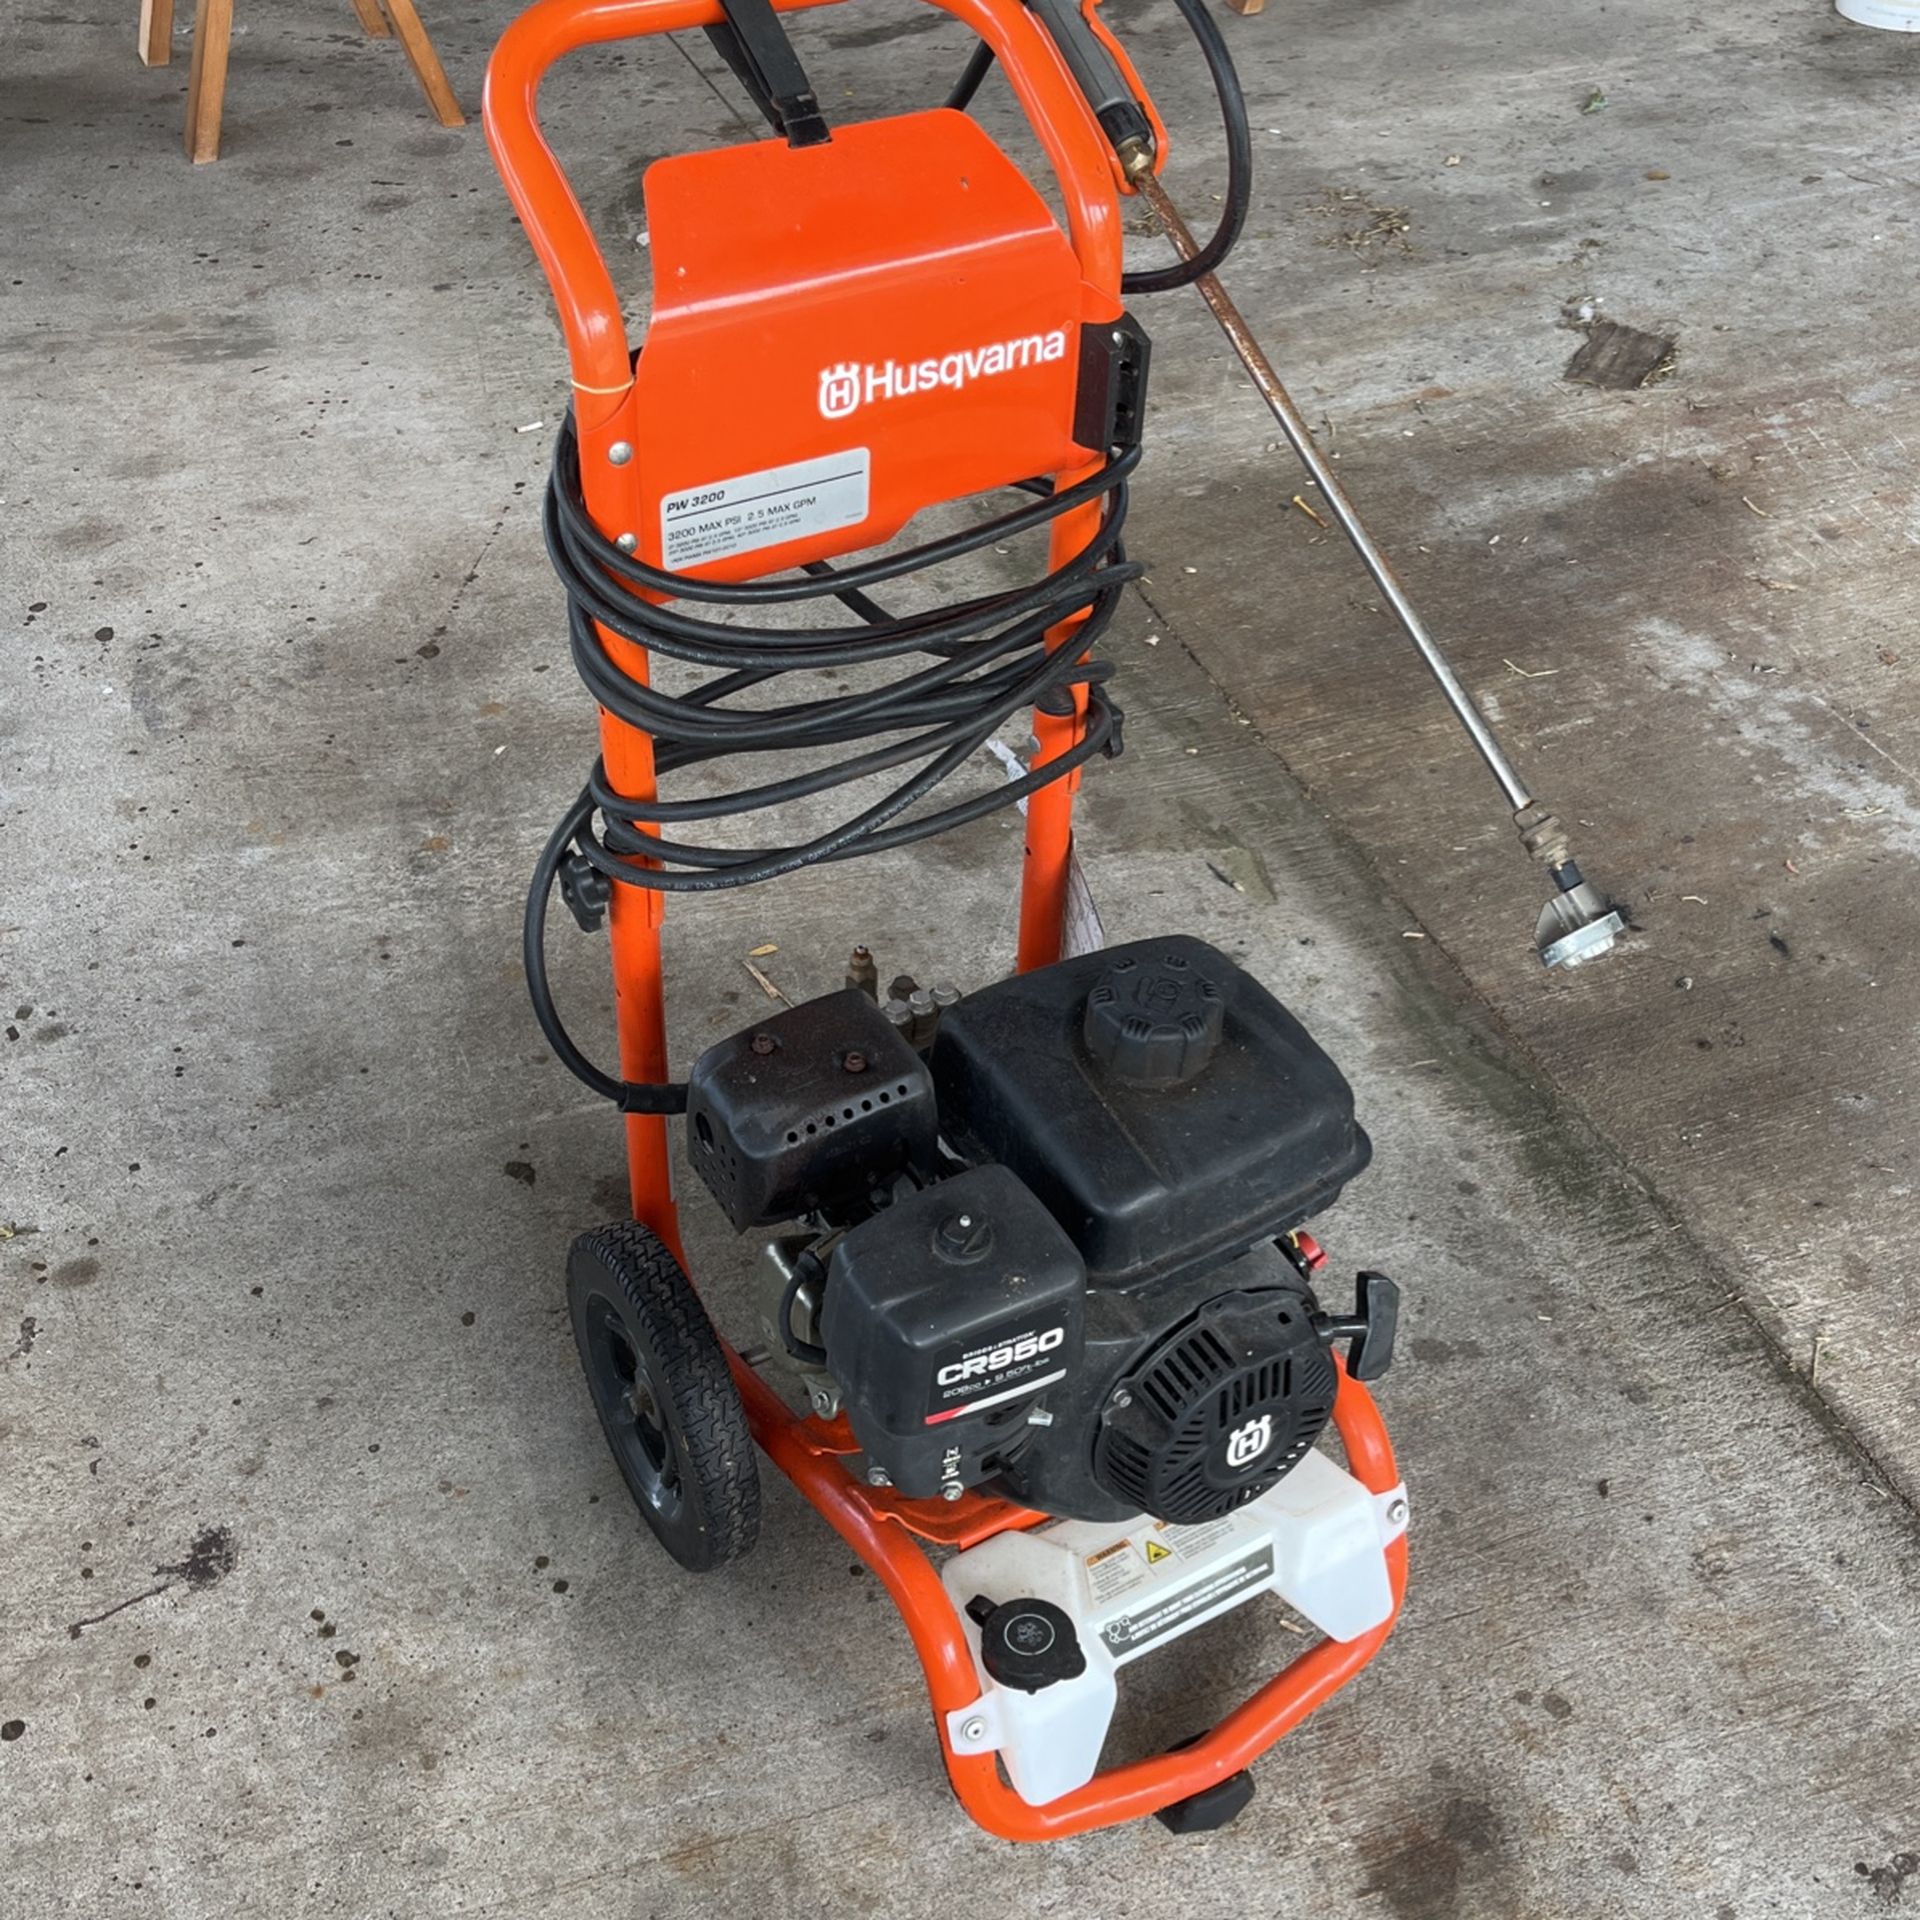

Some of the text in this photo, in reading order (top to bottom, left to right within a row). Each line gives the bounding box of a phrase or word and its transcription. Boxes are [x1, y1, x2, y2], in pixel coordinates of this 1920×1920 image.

[864, 330, 1066, 404] Husqvarna
[666, 489, 726, 514] PW 3200
[667, 527, 697, 542] 3200
[699, 521, 724, 536] MAX
[724, 516, 742, 528] PSI
[767, 503, 792, 518] MAX
[793, 496, 817, 510] GPM
[937, 1327, 1065, 1387] CR950
